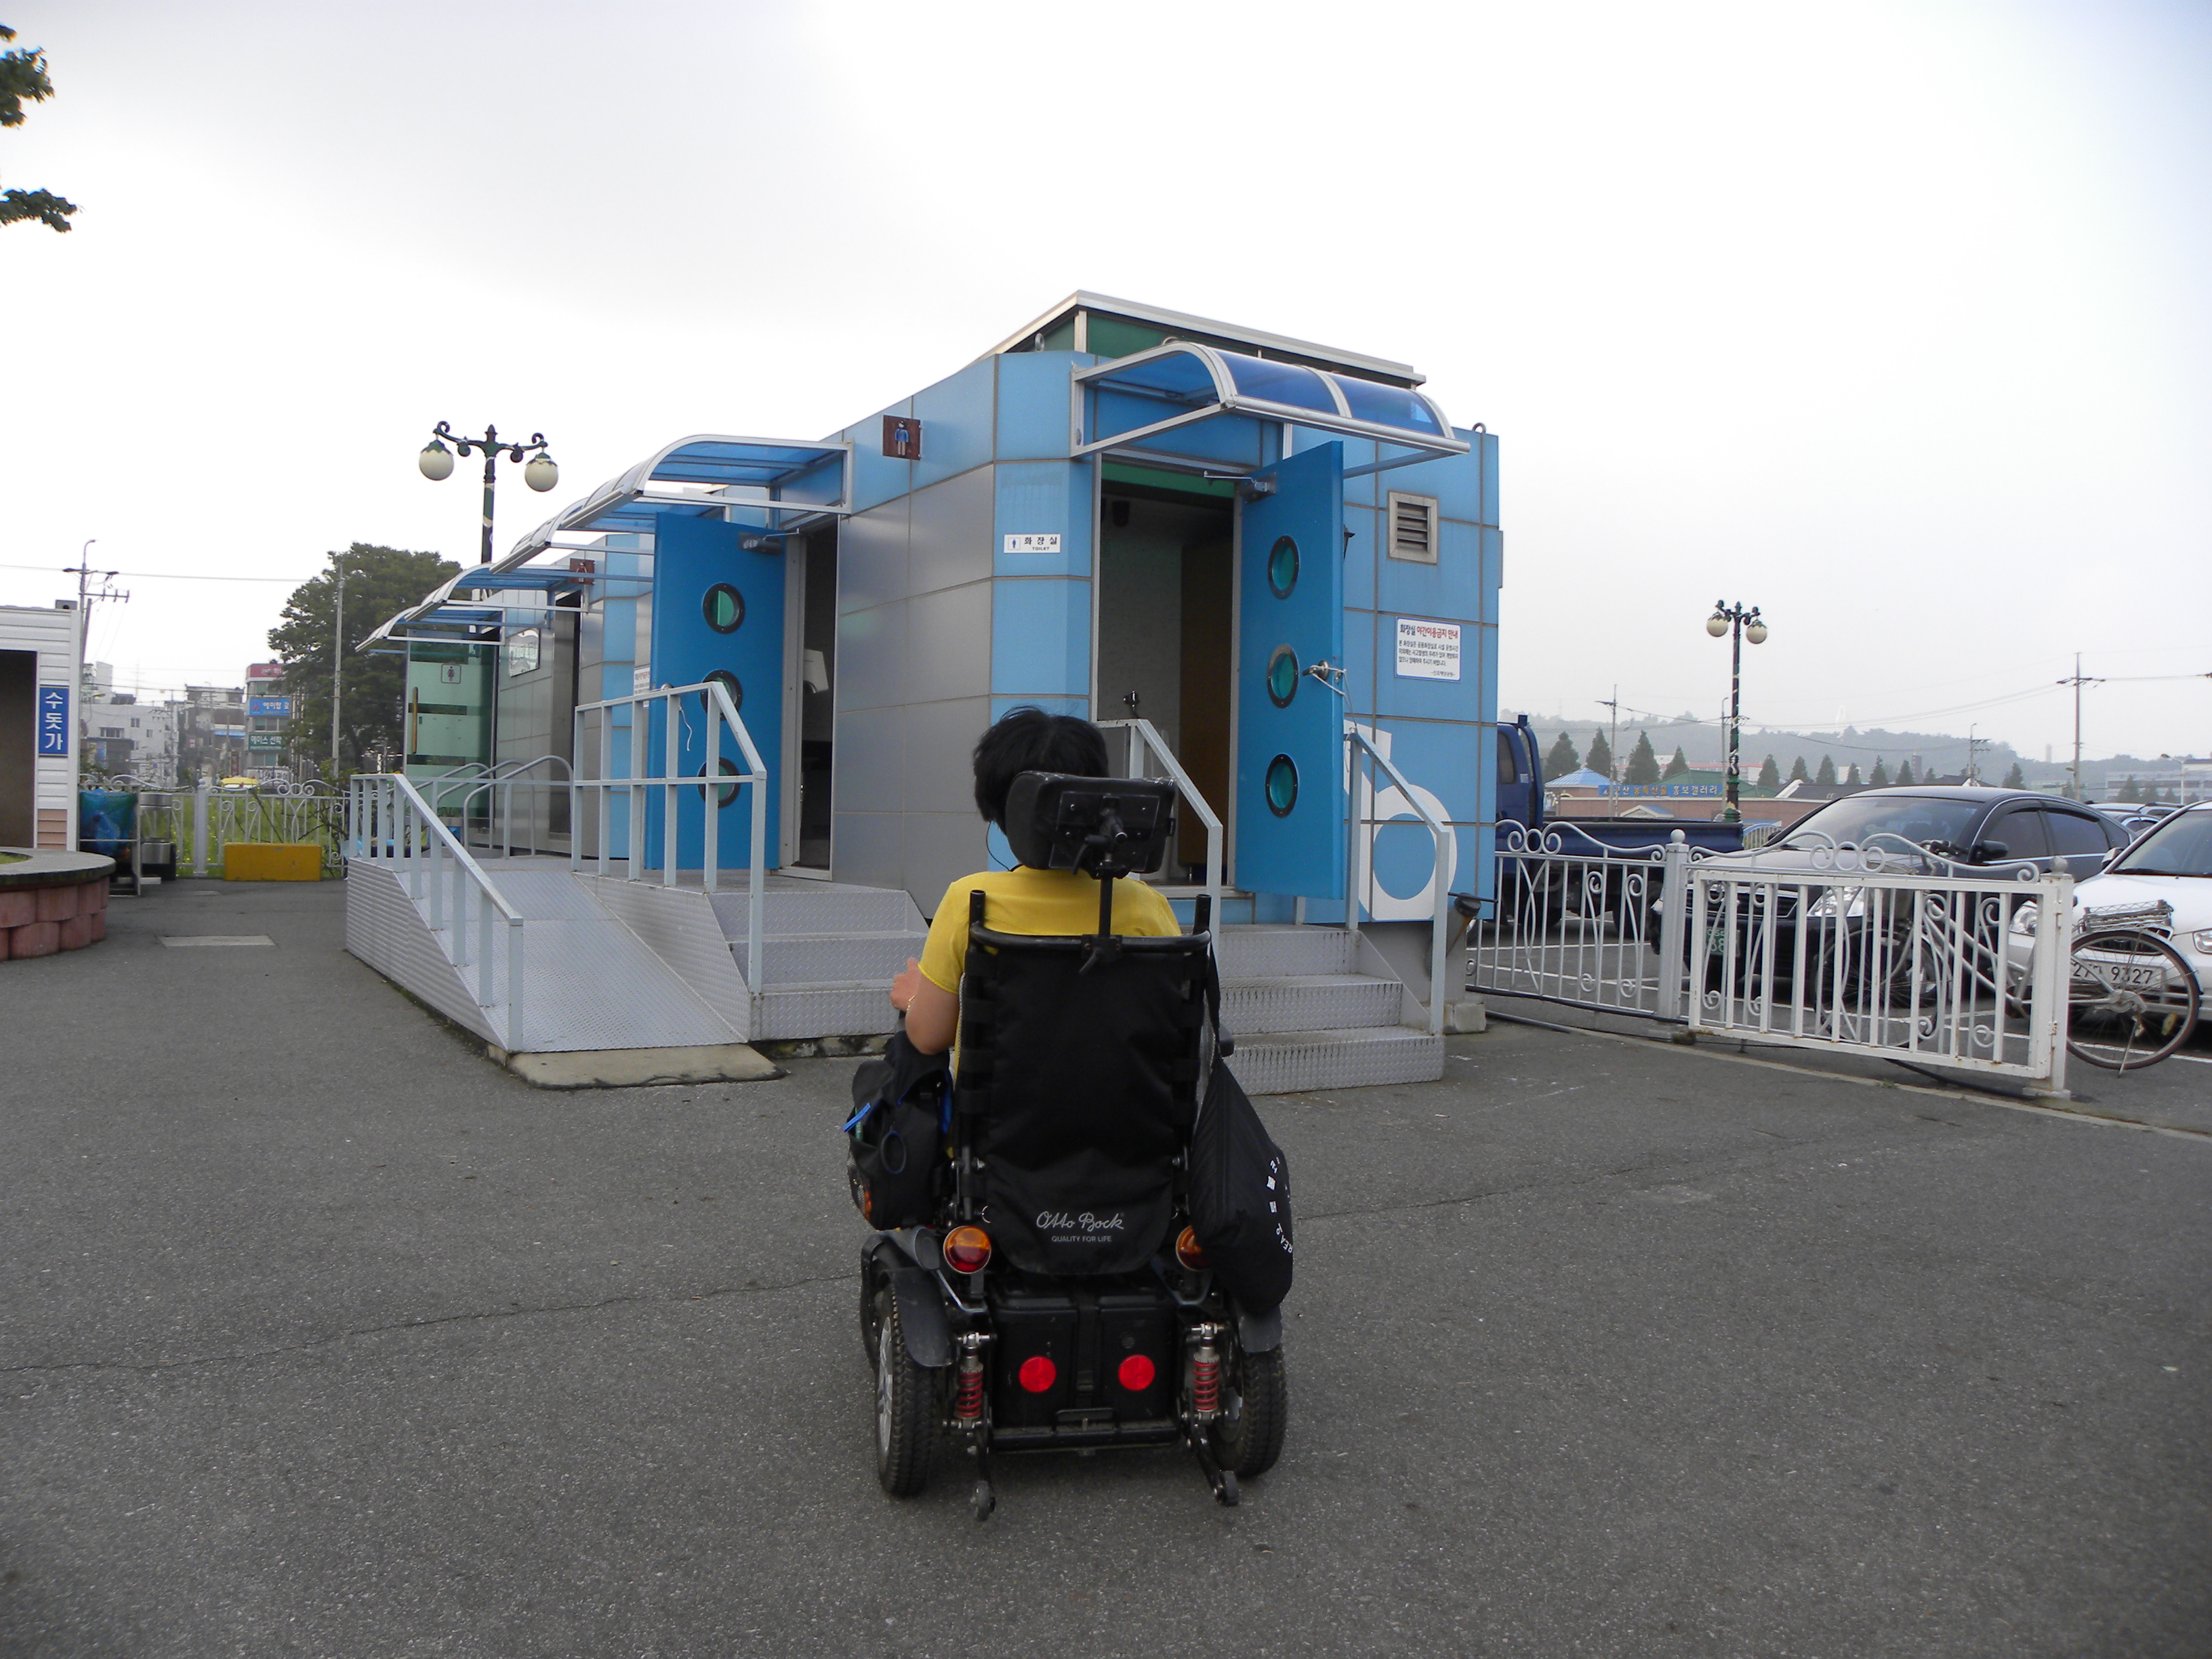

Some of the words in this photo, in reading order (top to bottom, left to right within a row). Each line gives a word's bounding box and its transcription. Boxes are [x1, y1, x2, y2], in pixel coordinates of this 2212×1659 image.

[1400, 624, 1416, 636] 화장실
[1417, 627, 1447, 638] 야간이용금지
[1448, 630, 1458, 639] 안내
[45, 692, 64, 750] 수돗가
[1673, 785, 1717, 796] 홍보갤러리
[1036, 1210, 1076, 1229] Otto
[1078, 1211, 1124, 1232] Bock
